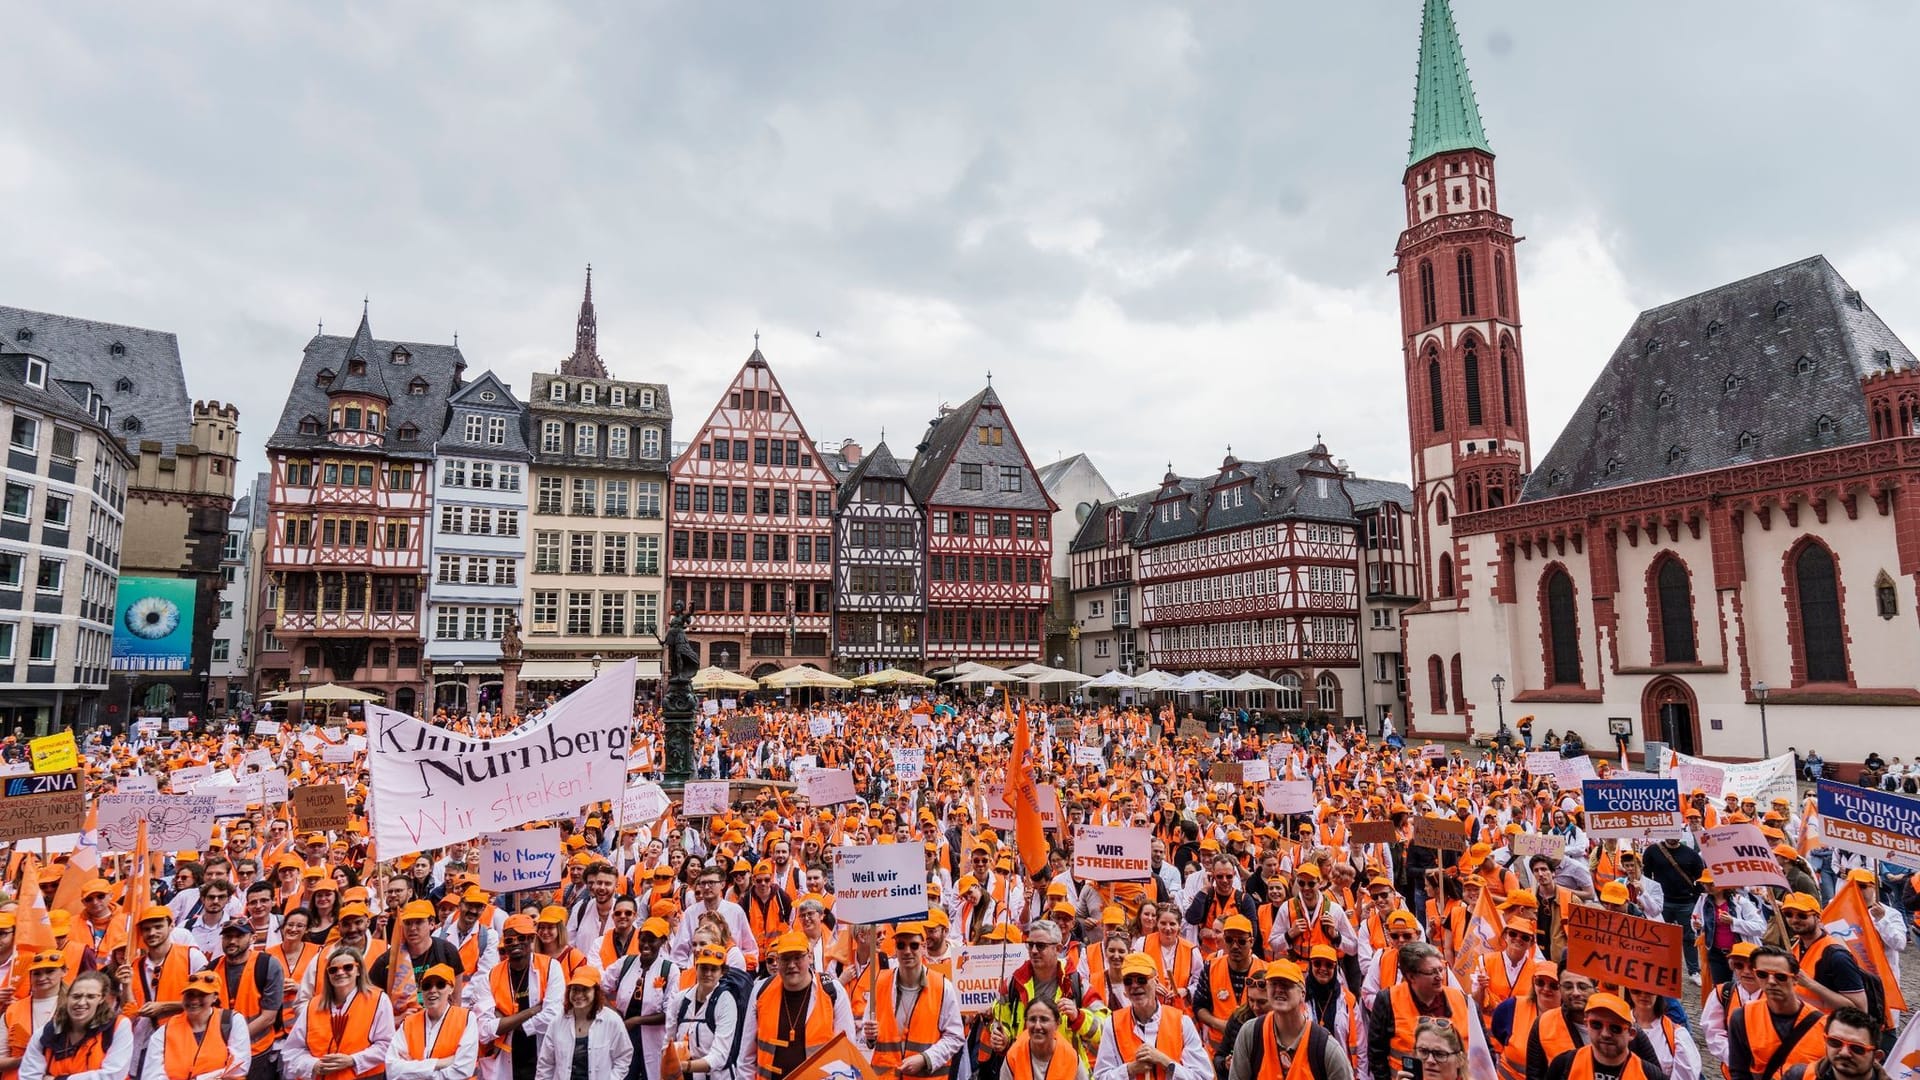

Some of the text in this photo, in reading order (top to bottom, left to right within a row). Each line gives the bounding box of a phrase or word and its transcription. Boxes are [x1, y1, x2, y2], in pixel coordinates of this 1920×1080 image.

[529, 650, 577, 660] Souvenirs
[33, 773, 77, 793] ZNA
[1598, 788, 1676, 800] KLINIKUM
[400, 800, 475, 845] Wir
[491, 761, 594, 823] streiken!
[1608, 800, 1677, 811] COBURG
[1592, 813, 1672, 829] Ärzte Streik
[1826, 819, 1867, 842] Ärzte
[1096, 844, 1123, 856] WIR
[1732, 845, 1771, 859] WIR
[516, 848, 556, 870] Money
[1076, 856, 1148, 871] STREIKEN!
[513, 869, 551, 884] Honey
[852, 869, 898, 883] Weil wir
[838, 884, 922, 899] mehr wert sind!
[1568, 906, 1662, 943] APPLAUS
[1619, 940, 1652, 954] keine
[1582, 951, 1678, 992] MIETE!
[957, 978, 1000, 992] QUALIT
[961, 992, 997, 1005] IHREN
